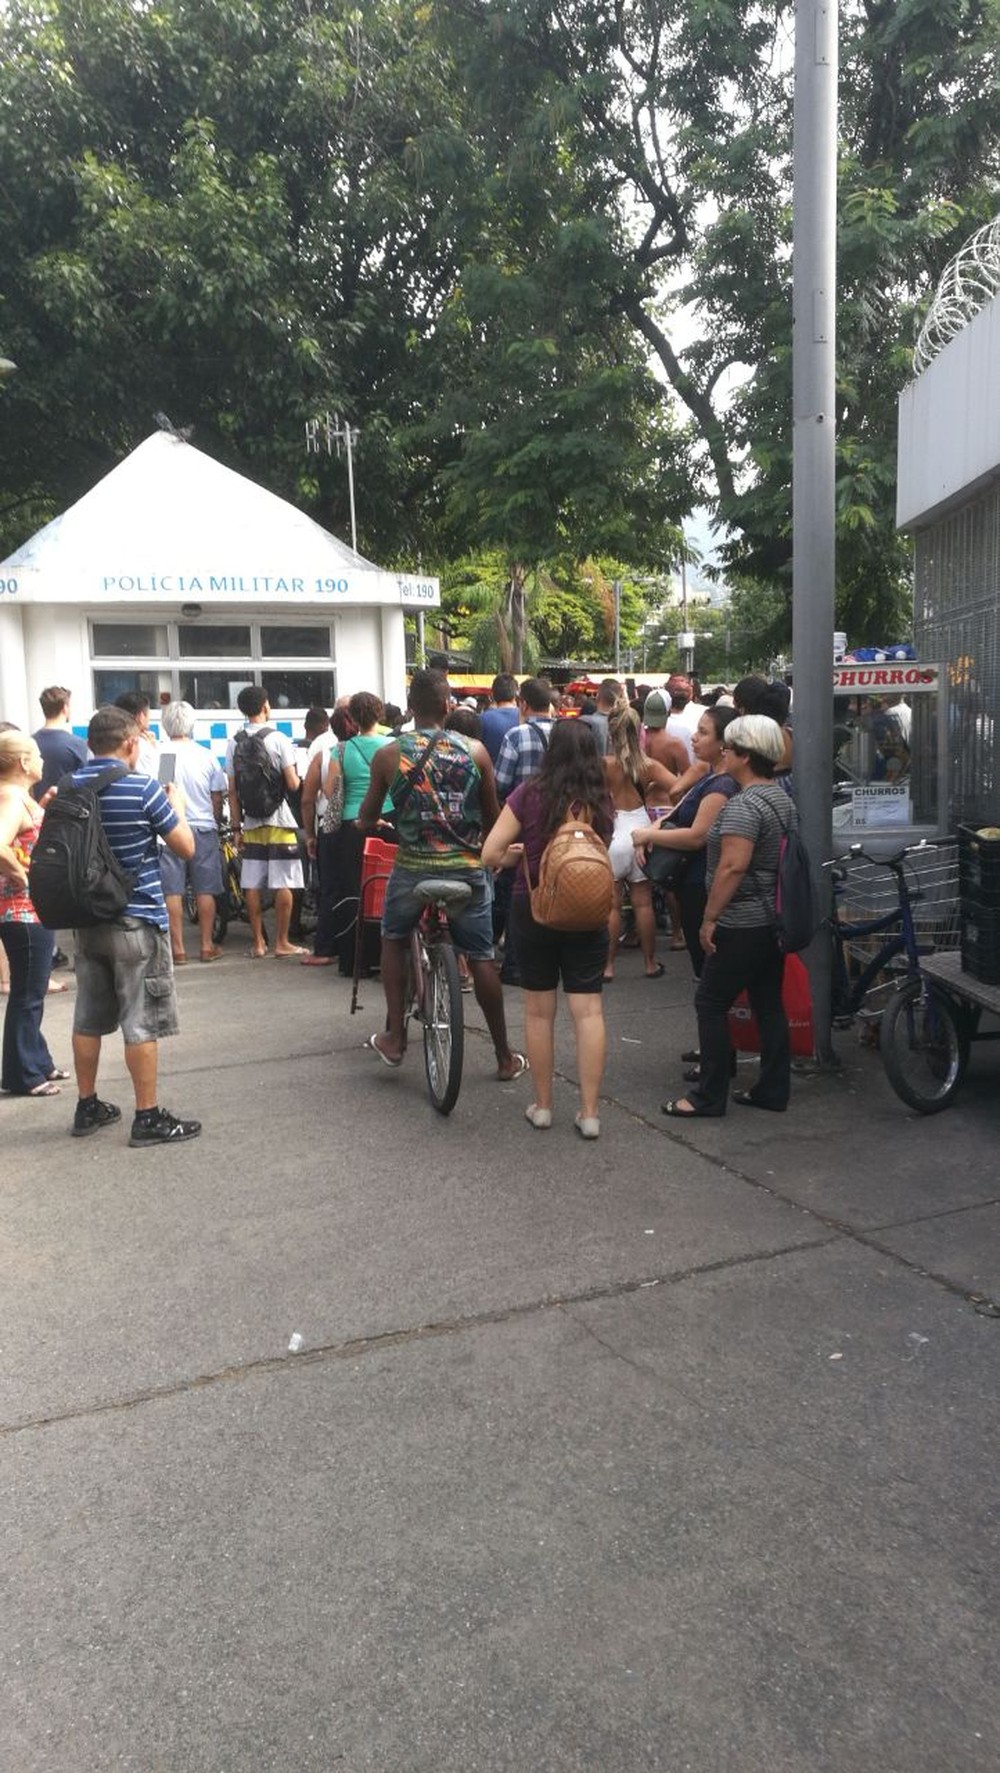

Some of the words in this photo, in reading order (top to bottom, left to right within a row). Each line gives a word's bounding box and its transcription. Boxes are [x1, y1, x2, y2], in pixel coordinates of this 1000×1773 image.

[209, 575, 305, 592] MILITAR
[314, 577, 349, 593] 190
[416, 583, 434, 599] 190
[854, 786, 907, 797] CHURROS
